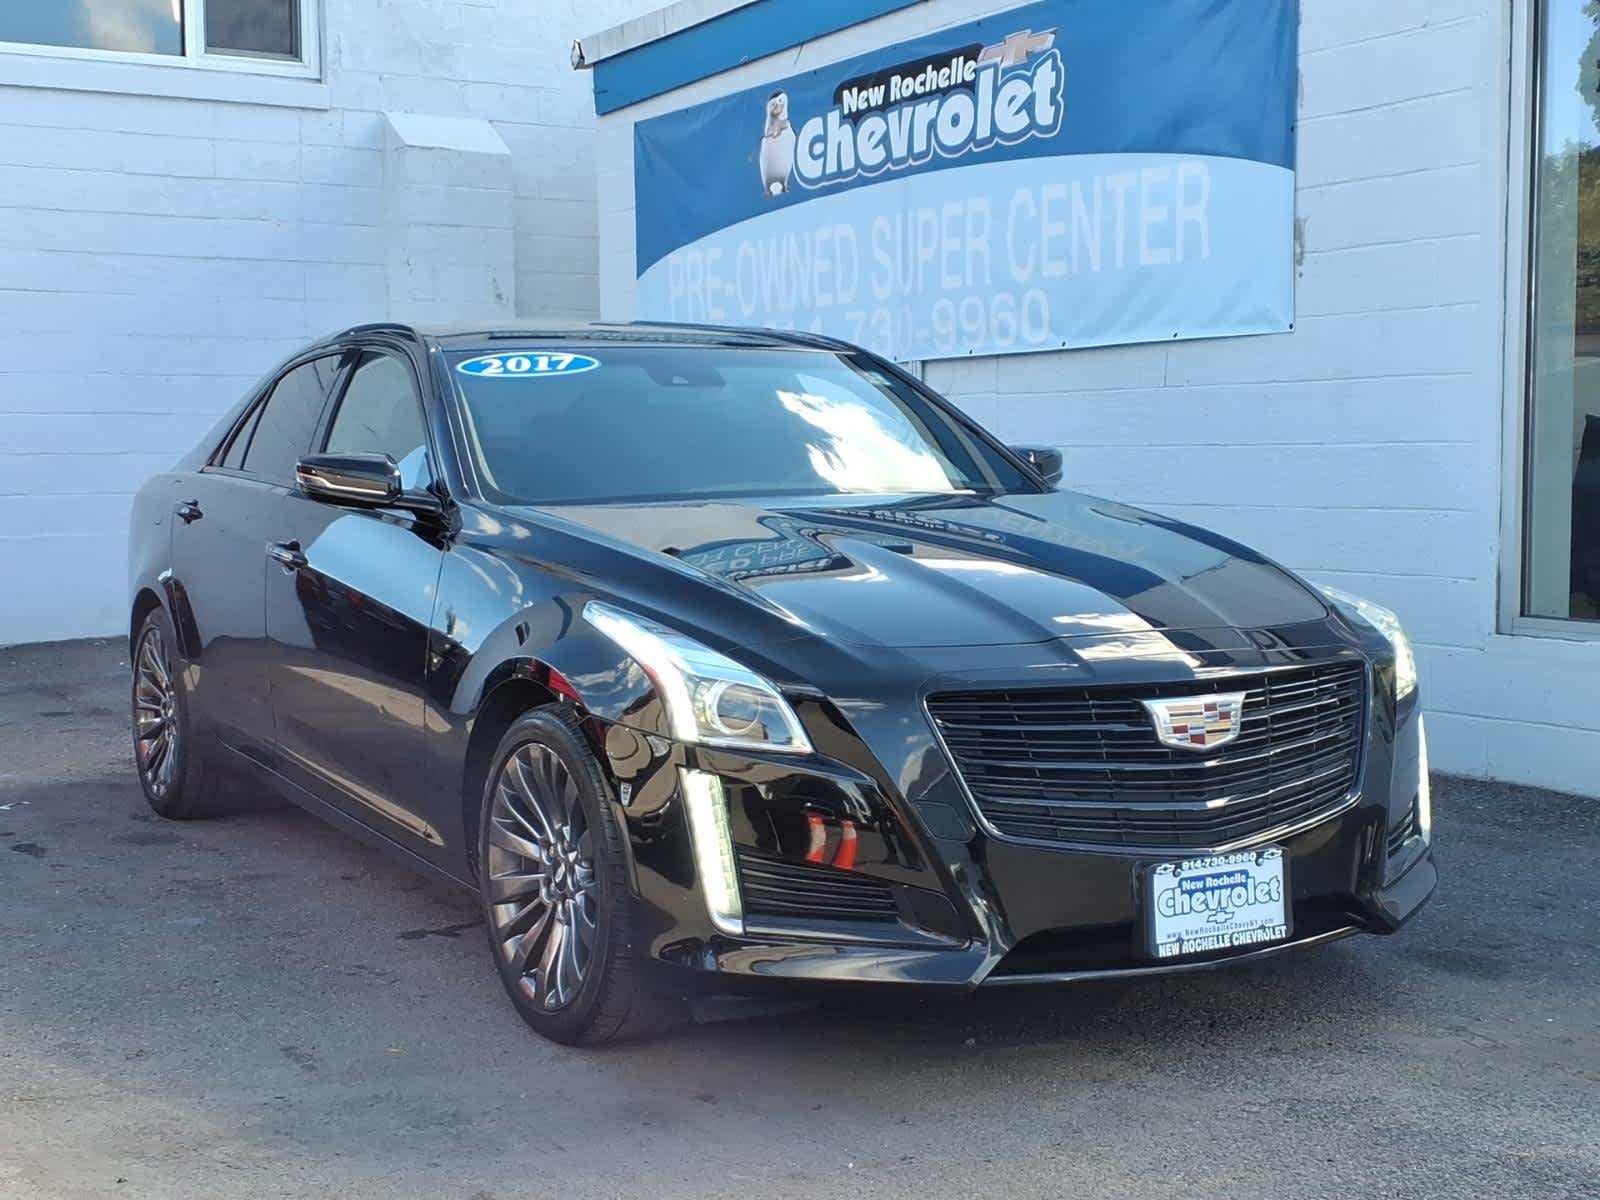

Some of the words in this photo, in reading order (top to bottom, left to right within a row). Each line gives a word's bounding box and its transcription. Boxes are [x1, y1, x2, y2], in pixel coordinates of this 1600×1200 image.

[842, 84, 885, 116] New
[890, 54, 977, 103] Rochelle
[796, 56, 1057, 180] Chevrolet
[669, 222, 859, 321] PRE-OWNED
[871, 196, 993, 300] SUPER
[1007, 159, 1211, 283] CENTER
[479, 353, 576, 376] 2017
[1181, 851, 1257, 872] 914-730-9960
[1157, 875, 1281, 918] Chevrolet
[1181, 879, 1204, 891] New
[1205, 872, 1247, 888] Rochelle
[1159, 941, 1180, 958] NEW
[1181, 932, 1232, 954] ROCHELLE
[1232, 925, 1287, 947] CHEVROLET
